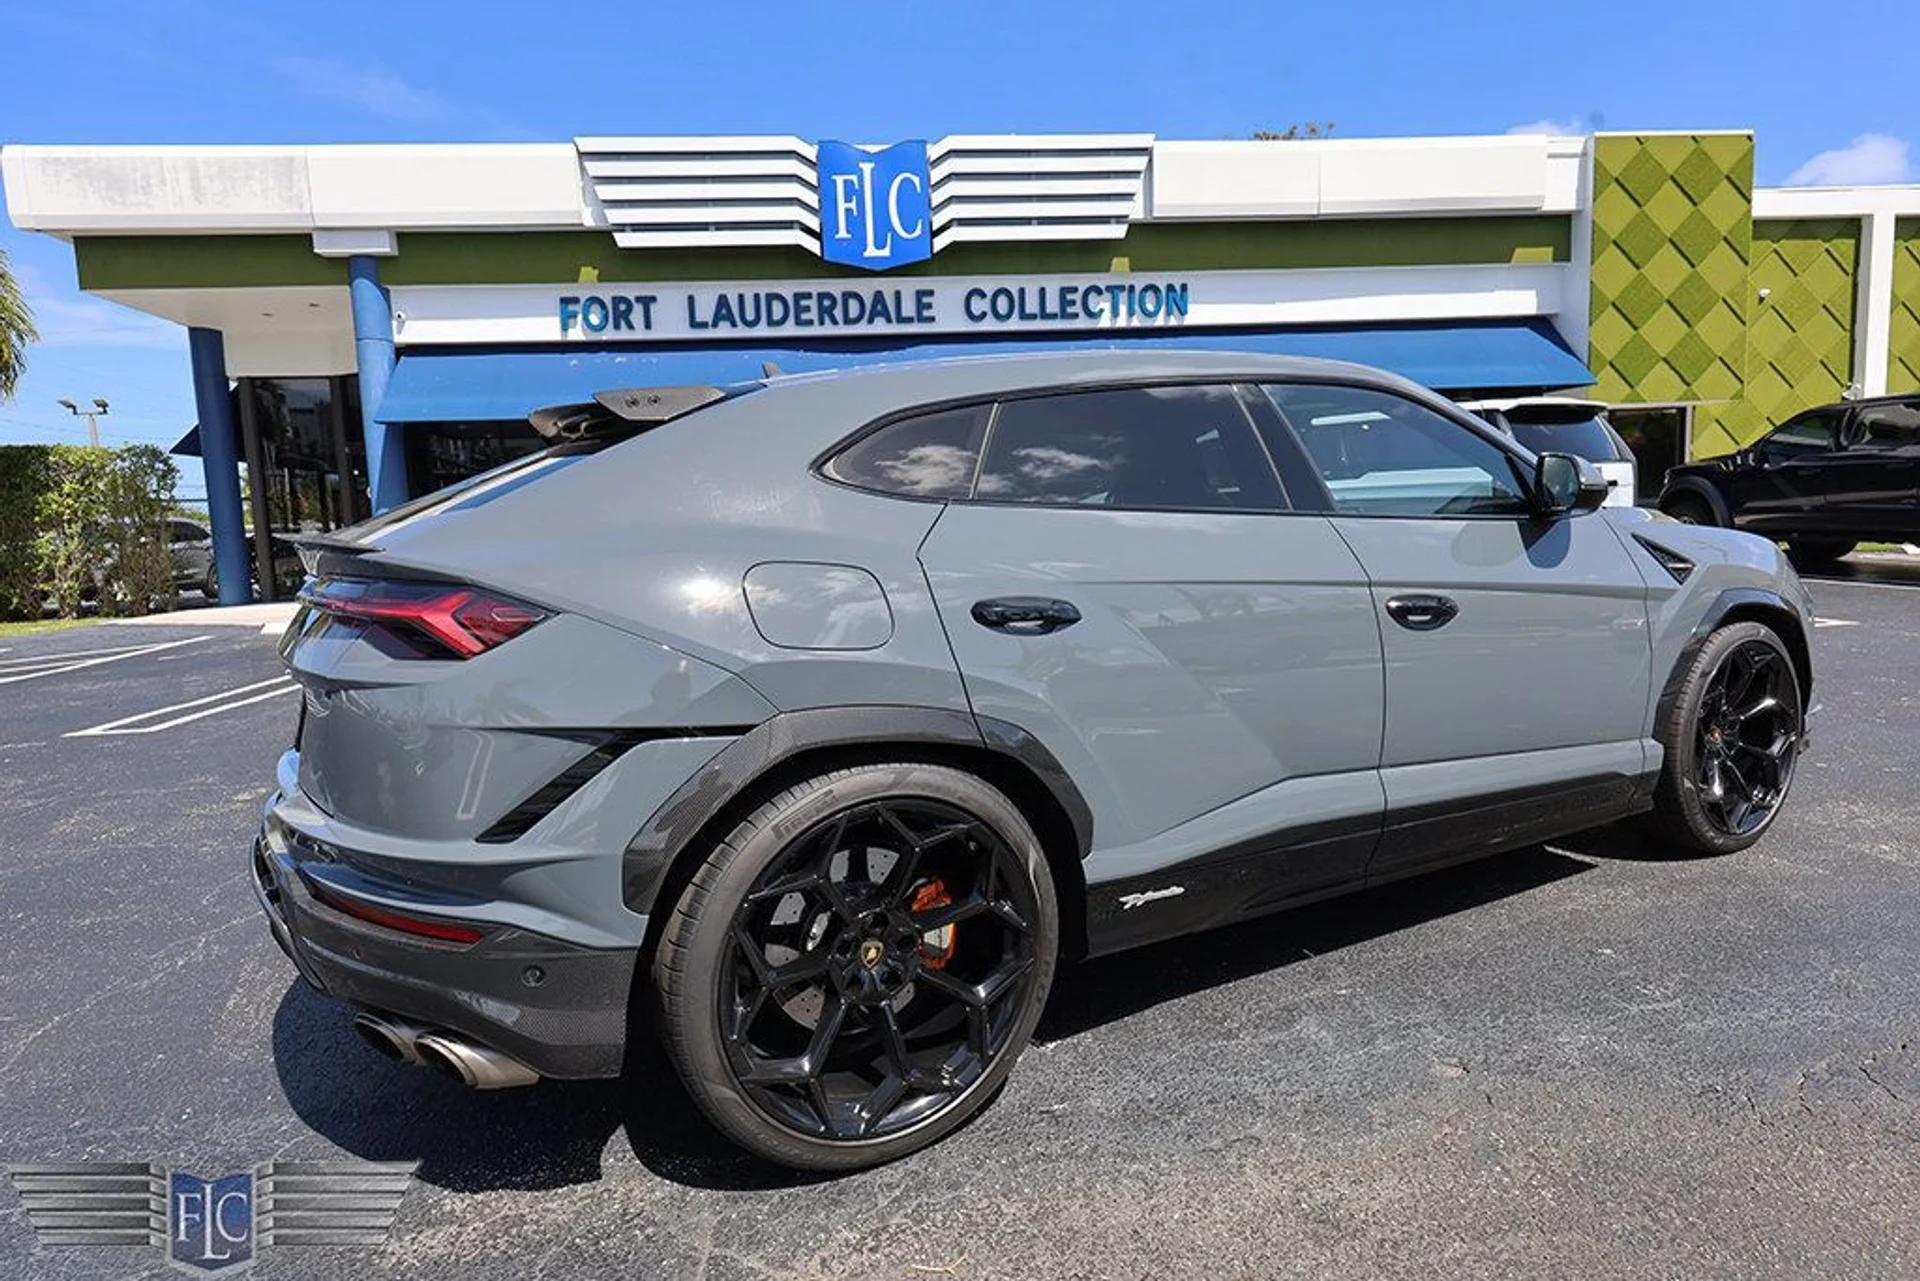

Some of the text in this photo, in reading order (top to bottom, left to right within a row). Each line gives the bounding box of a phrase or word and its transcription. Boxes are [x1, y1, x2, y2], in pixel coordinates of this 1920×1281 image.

[833, 162, 922, 257] FLC
[560, 284, 1188, 332] FORT LAUDERDALE COLLECTION
